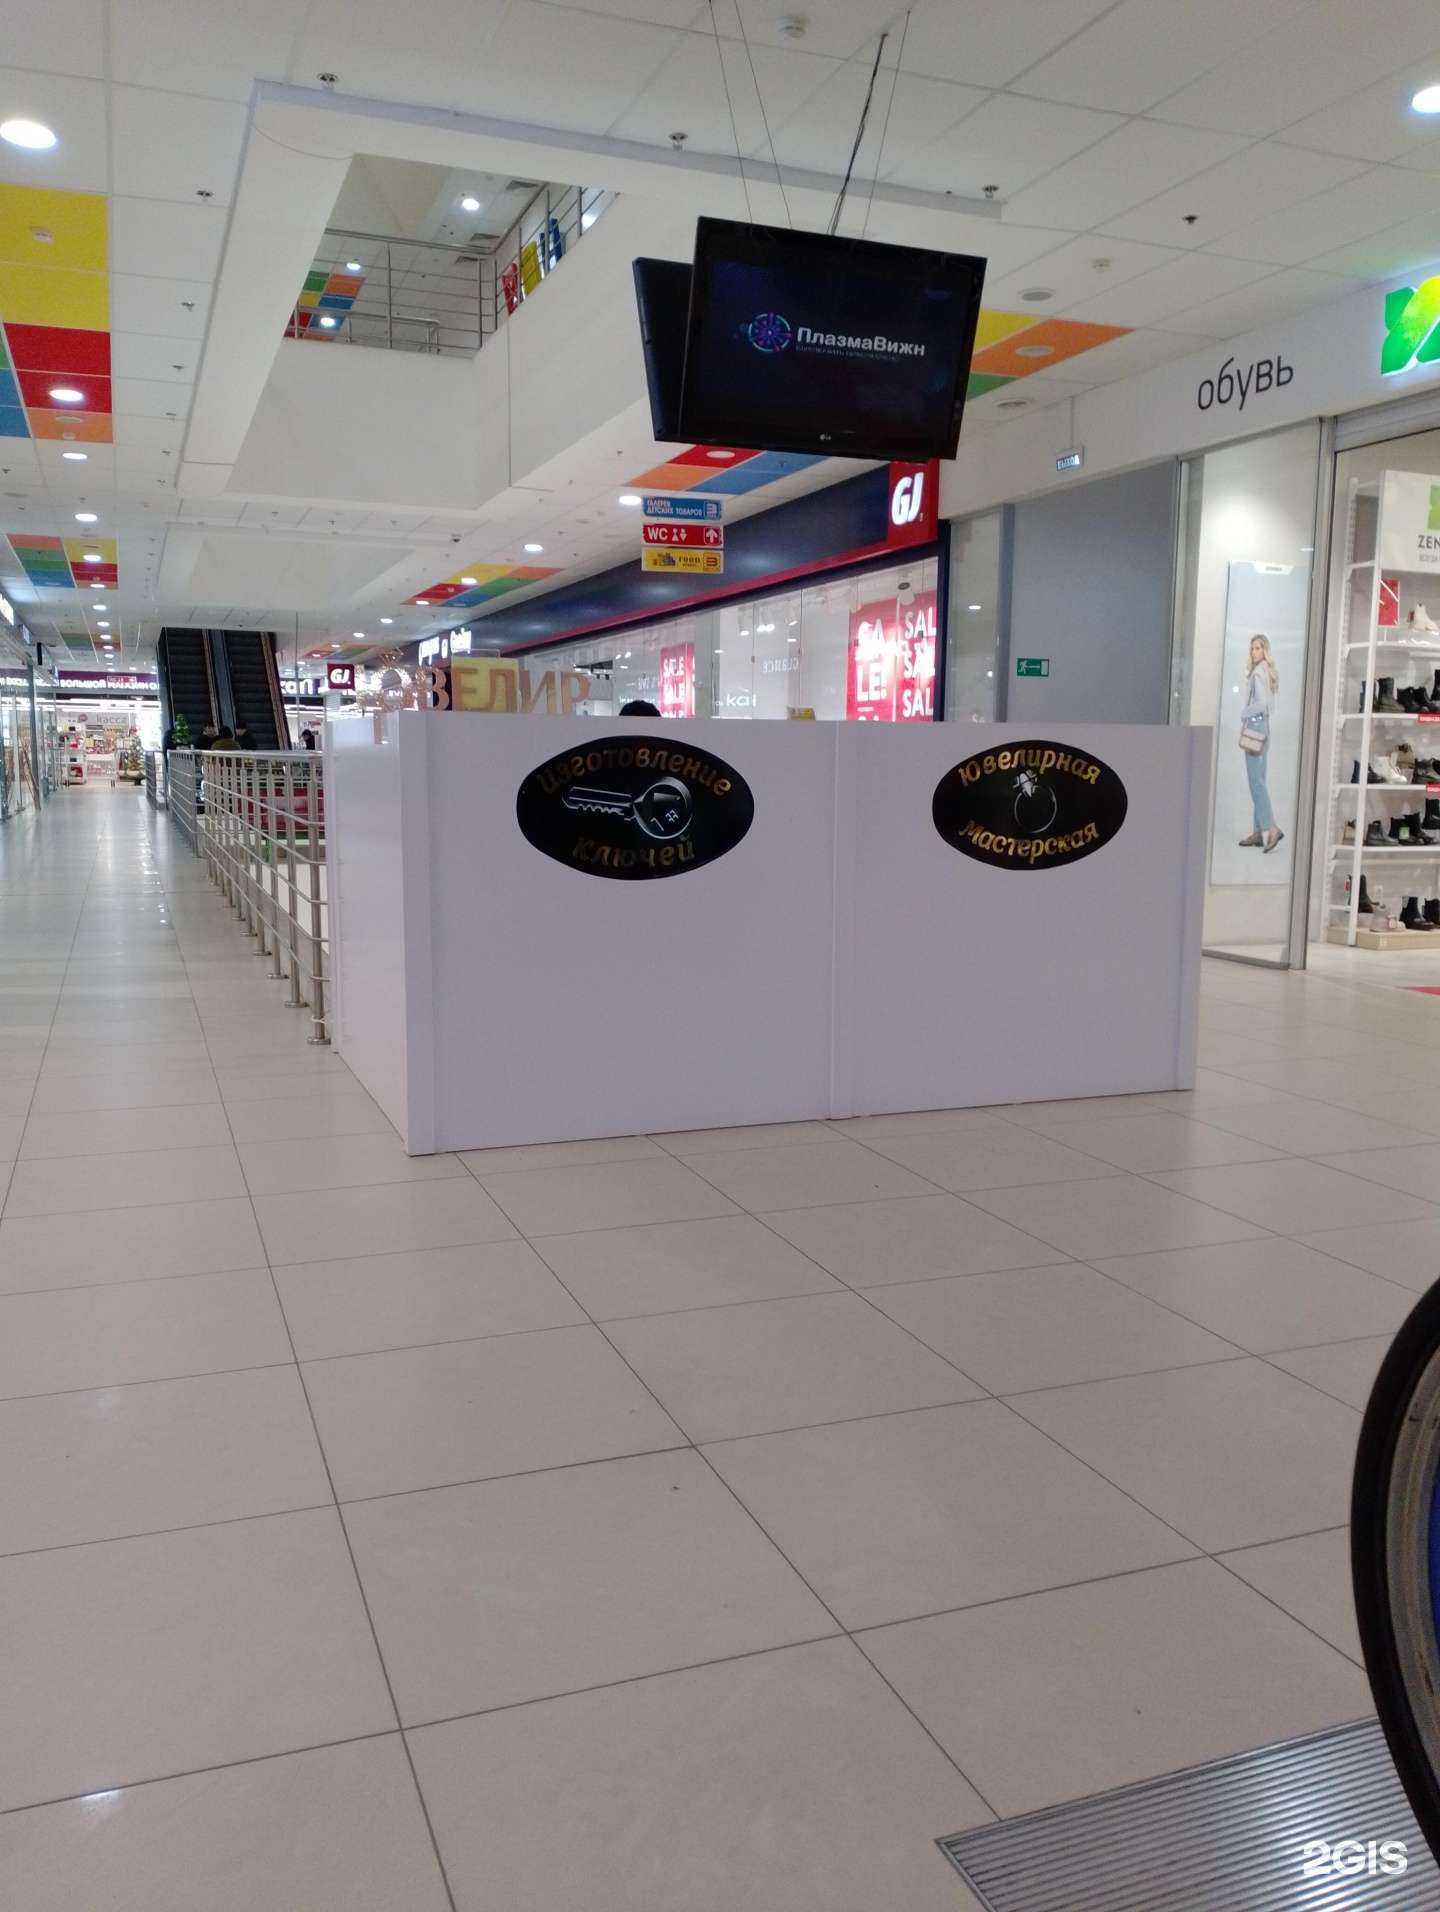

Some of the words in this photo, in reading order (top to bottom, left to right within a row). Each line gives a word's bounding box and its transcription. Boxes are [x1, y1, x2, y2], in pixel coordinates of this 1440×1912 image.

[796, 326, 926, 357] ПлазмаВижн
[1197, 356, 1294, 411] обувь
[647, 527, 669, 541] WC
[958, 749, 1101, 787] Ювелирная
